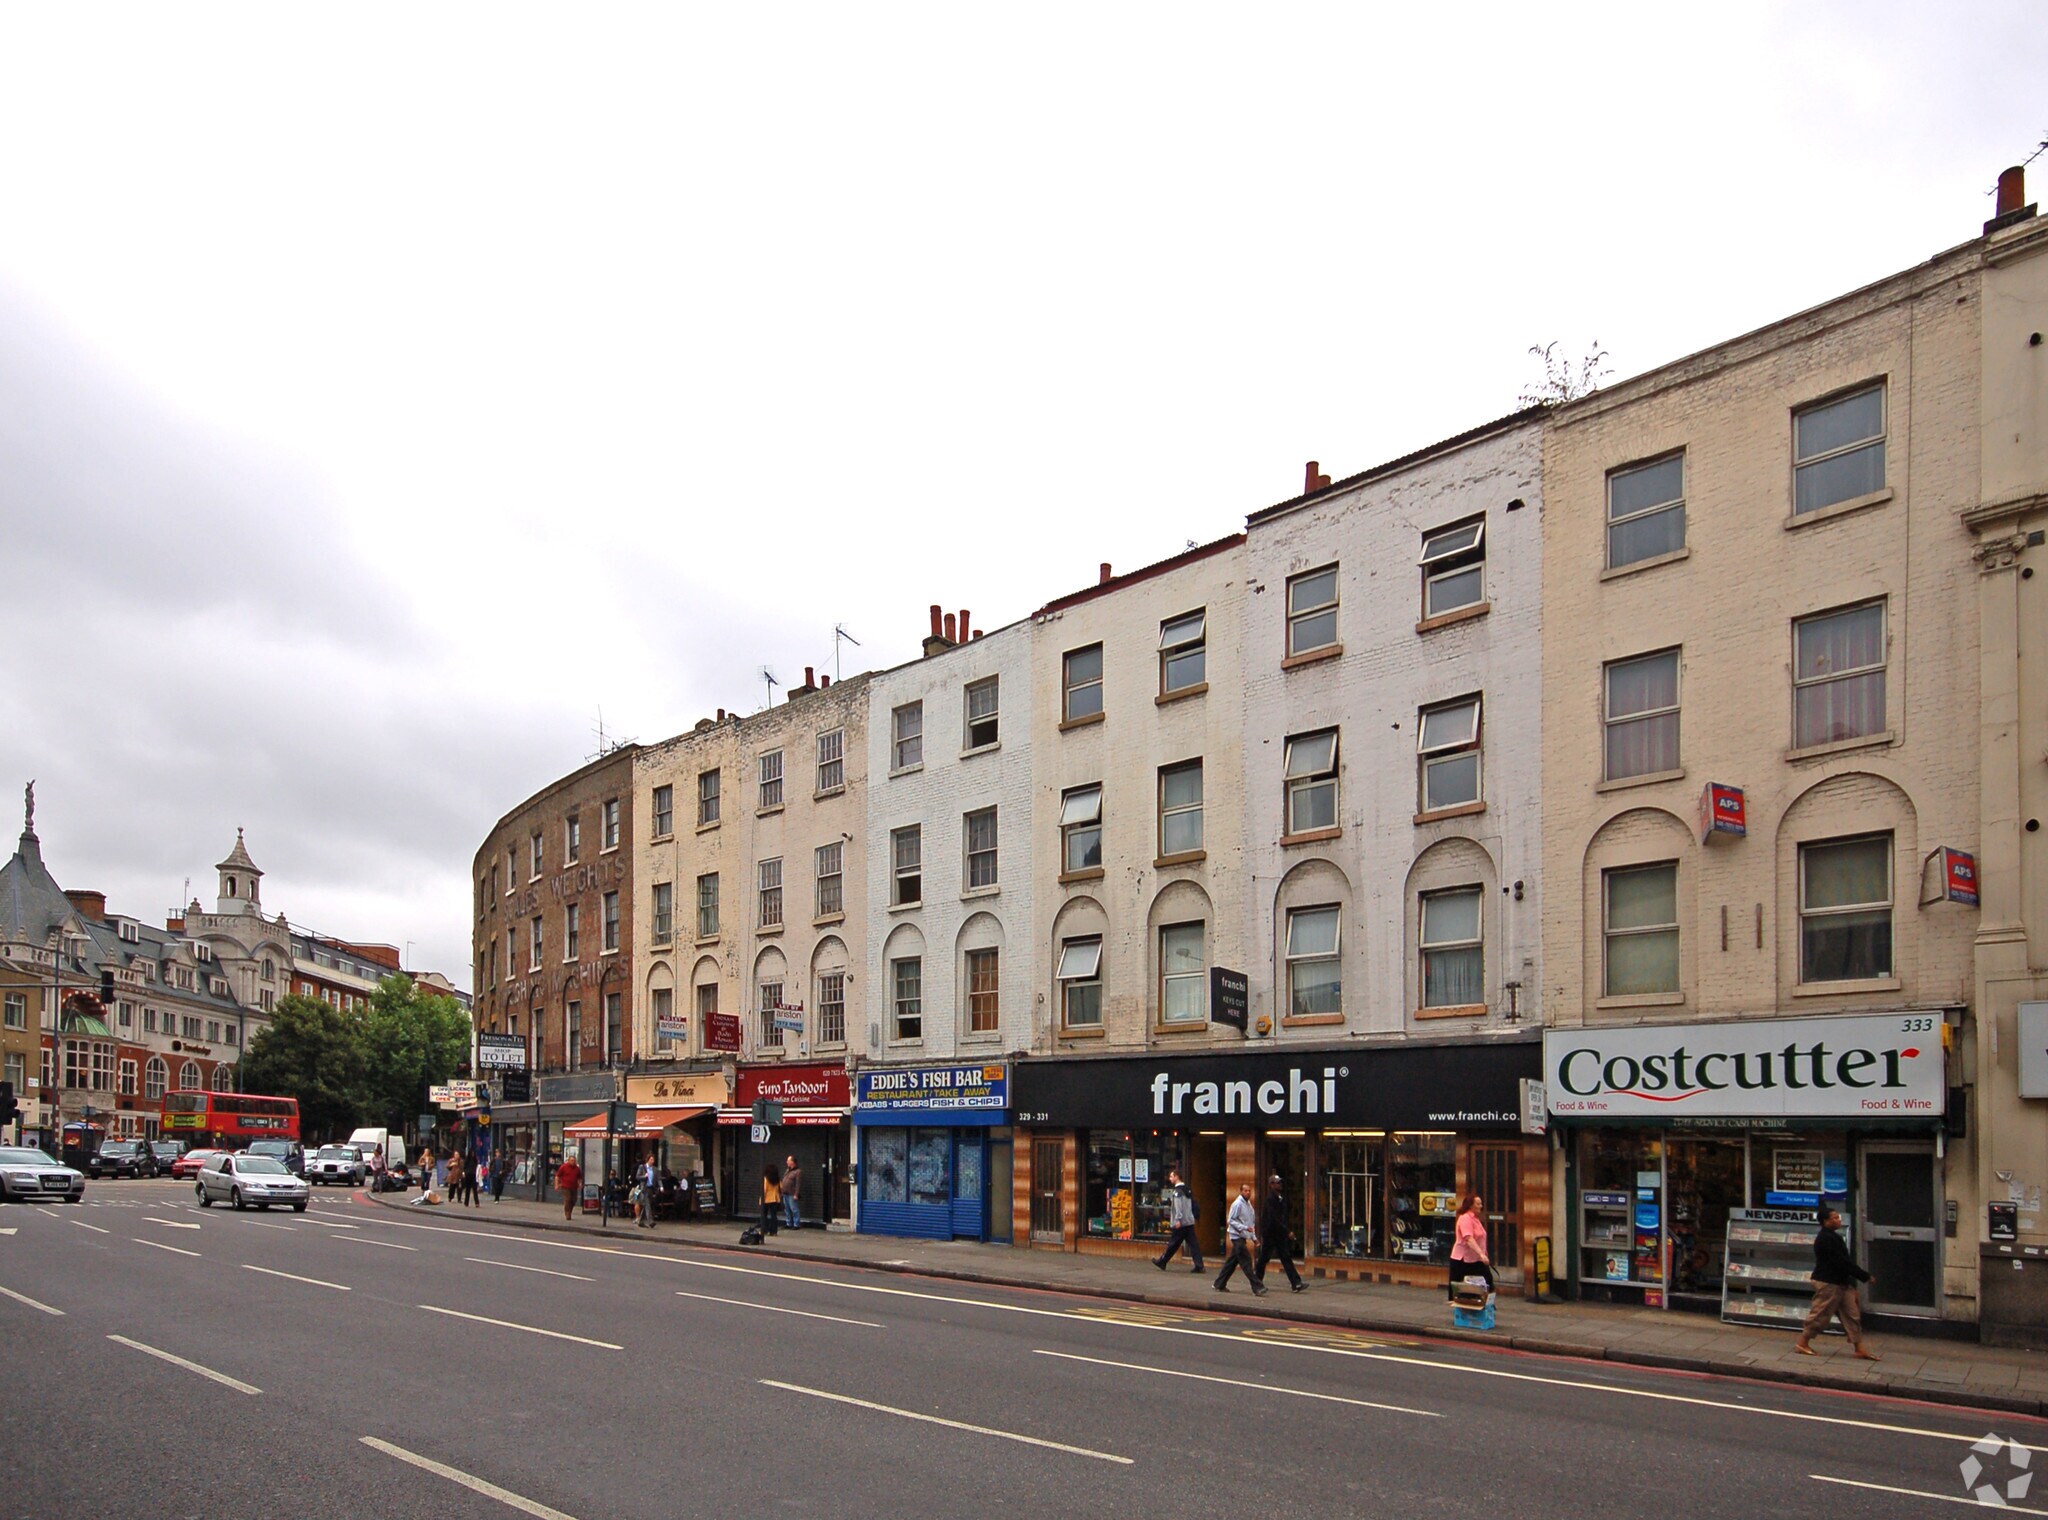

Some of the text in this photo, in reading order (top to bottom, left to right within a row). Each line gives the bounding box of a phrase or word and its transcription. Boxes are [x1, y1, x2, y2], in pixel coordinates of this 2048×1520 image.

[1719, 798, 1739, 811] APS
[1954, 864, 1972, 878] APS
[1221, 976, 1246, 992] franchi
[776, 1010, 802, 1019] ariston
[1227, 1008, 1240, 1017] HERE
[661, 1022, 685, 1030] ariston
[1901, 1018, 1933, 1032] 333
[482, 1052, 523, 1063] TO LET
[1558, 1041, 1920, 1096] Costcutter
[871, 1071, 918, 1090] EDDIE'S
[922, 1071, 951, 1088] FISH
[955, 1069, 982, 1087] BAR
[653, 1080, 696, 1097] Da Vinci
[757, 1080, 829, 1095] Euro Tandoori
[790, 1095, 810, 1103] Cuisine
[866, 1091, 928, 1100] RESTAURANT
[933, 1089, 959, 1097] TAKE
[963, 1087, 991, 1096] AWAY
[857, 1101, 887, 1109] KEBABS
[893, 1099, 930, 1108] BURGERS
[932, 1099, 955, 1107] FISH
[968, 1097, 1001, 1106] CHIPS
[1556, 1101, 1608, 1110] Food & Wine
[1861, 1098, 1932, 1109] Food & Wine
[1019, 1112, 1031, 1121] 329
[1037, 1112, 1049, 1121] 331
[1694, 1118, 1726, 1127] SERVICE
[1728, 1118, 1749, 1127] CASH
[1751, 1118, 1788, 1127] MACHINE
[1801, 1164, 1820, 1172] Wines
